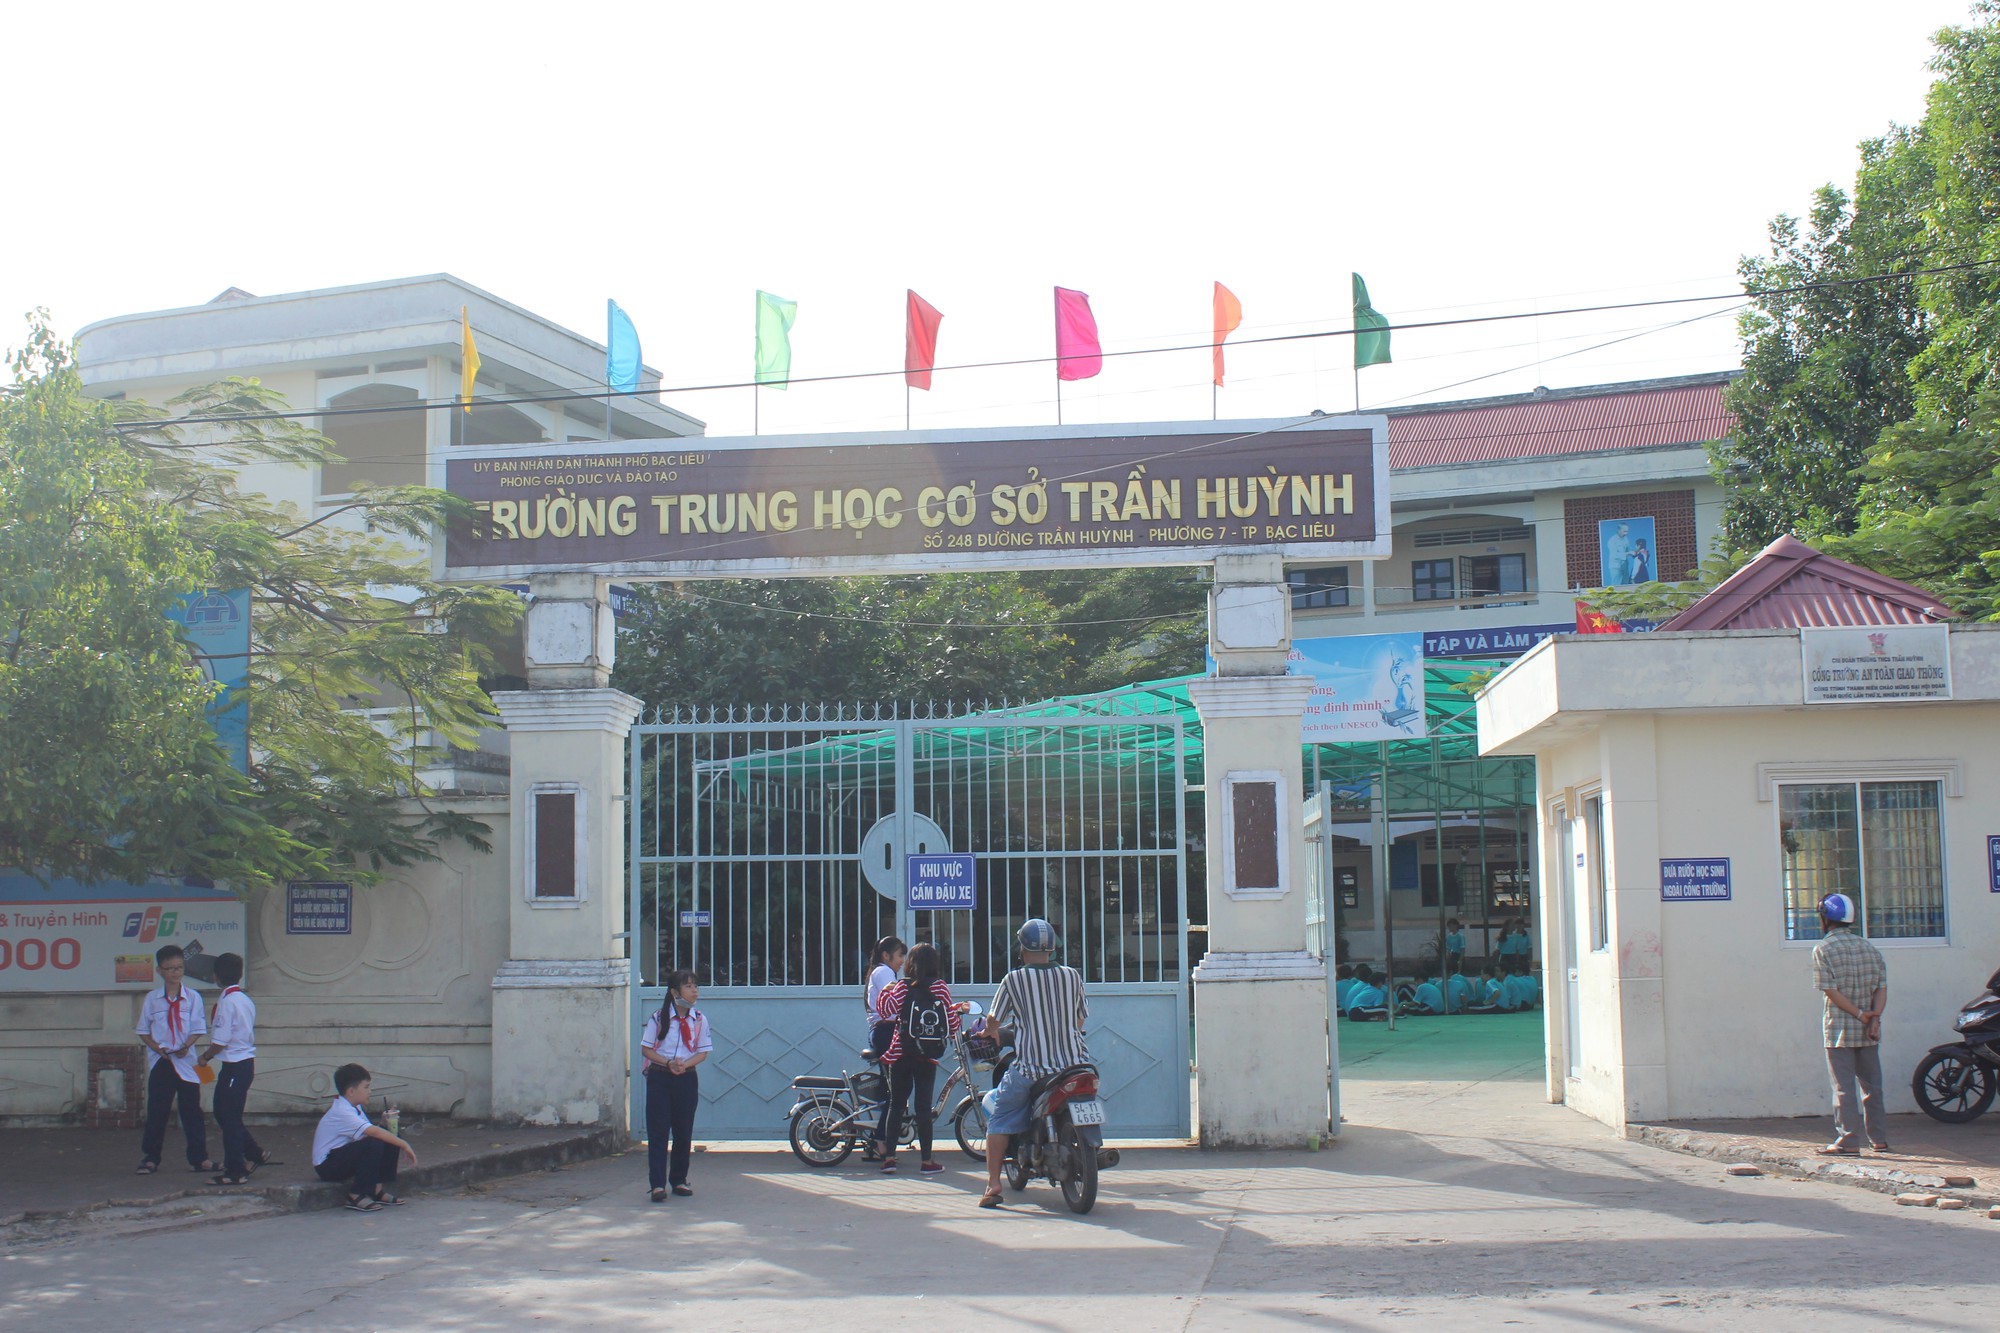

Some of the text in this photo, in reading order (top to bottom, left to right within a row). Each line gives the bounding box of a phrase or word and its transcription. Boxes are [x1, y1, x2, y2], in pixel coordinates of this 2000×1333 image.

[494, 461, 517, 472] BAN
[520, 457, 553, 471] NHÂN
[556, 456, 582, 469] DÂN
[625, 453, 649, 467] PHỐ
[651, 455, 677, 467] BẠC
[680, 453, 705, 465] LIÊU
[500, 474, 541, 487] PHÒNG
[544, 473, 575, 485] GIÁO
[606, 471, 623, 483] VÀ
[626, 470, 652, 482] ĐÀO
[655, 471, 678, 484] TẠO
[651, 490, 798, 535] TRUNG
[814, 487, 903, 539] HỌC
[917, 480, 976, 527] CƠ
[991, 467, 1048, 525] SỞ
[1061, 464, 1181, 522] TRẦN
[1197, 465, 1354, 519] HUỲNH
[924, 530, 944, 548] SỐ
[947, 534, 973, 548] 248
[977, 530, 1034, 547] ĐƯỜNG
[1038, 526, 1075, 546] TRẦN
[1080, 527, 1134, 544] HUỲNH
[1218, 526, 1226, 539] 7
[1241, 526, 1257, 539] TP
[1266, 525, 1298, 541] BẠC
[1302, 521, 1335, 538] LIÊU
[1426, 636, 1460, 654] TẬP
[1465, 634, 1488, 650] VÀ
[1493, 632, 1530, 648] LÀM
[1861, 668, 1873, 681] AN
[1874, 665, 1895, 680] TOÀN
[1897, 667, 1915, 680] GIAO
[1917, 664, 1944, 680] THÔNG
[1311, 683, 1336, 696] ống,
[1324, 702, 1349, 715] định
[1321, 722, 1338, 731] theo
[1340, 721, 1378, 730] UNESCO
[920, 860, 963, 880] KHU VỰC
[1696, 865, 1709, 879] HỌC
[1710, 865, 1725, 877] SINH
[911, 881, 971, 903] CẤM ĐẬU XE
[1663, 878, 1727, 897] NGOÀI CỔNG TRƯỜNG
[14, 909, 67, 930] Truyền
[73, 911, 107, 926] Hình
[1074, 1103, 1098, 1113] 54-Y1
[1077, 1112, 1102, 1123] 4665
